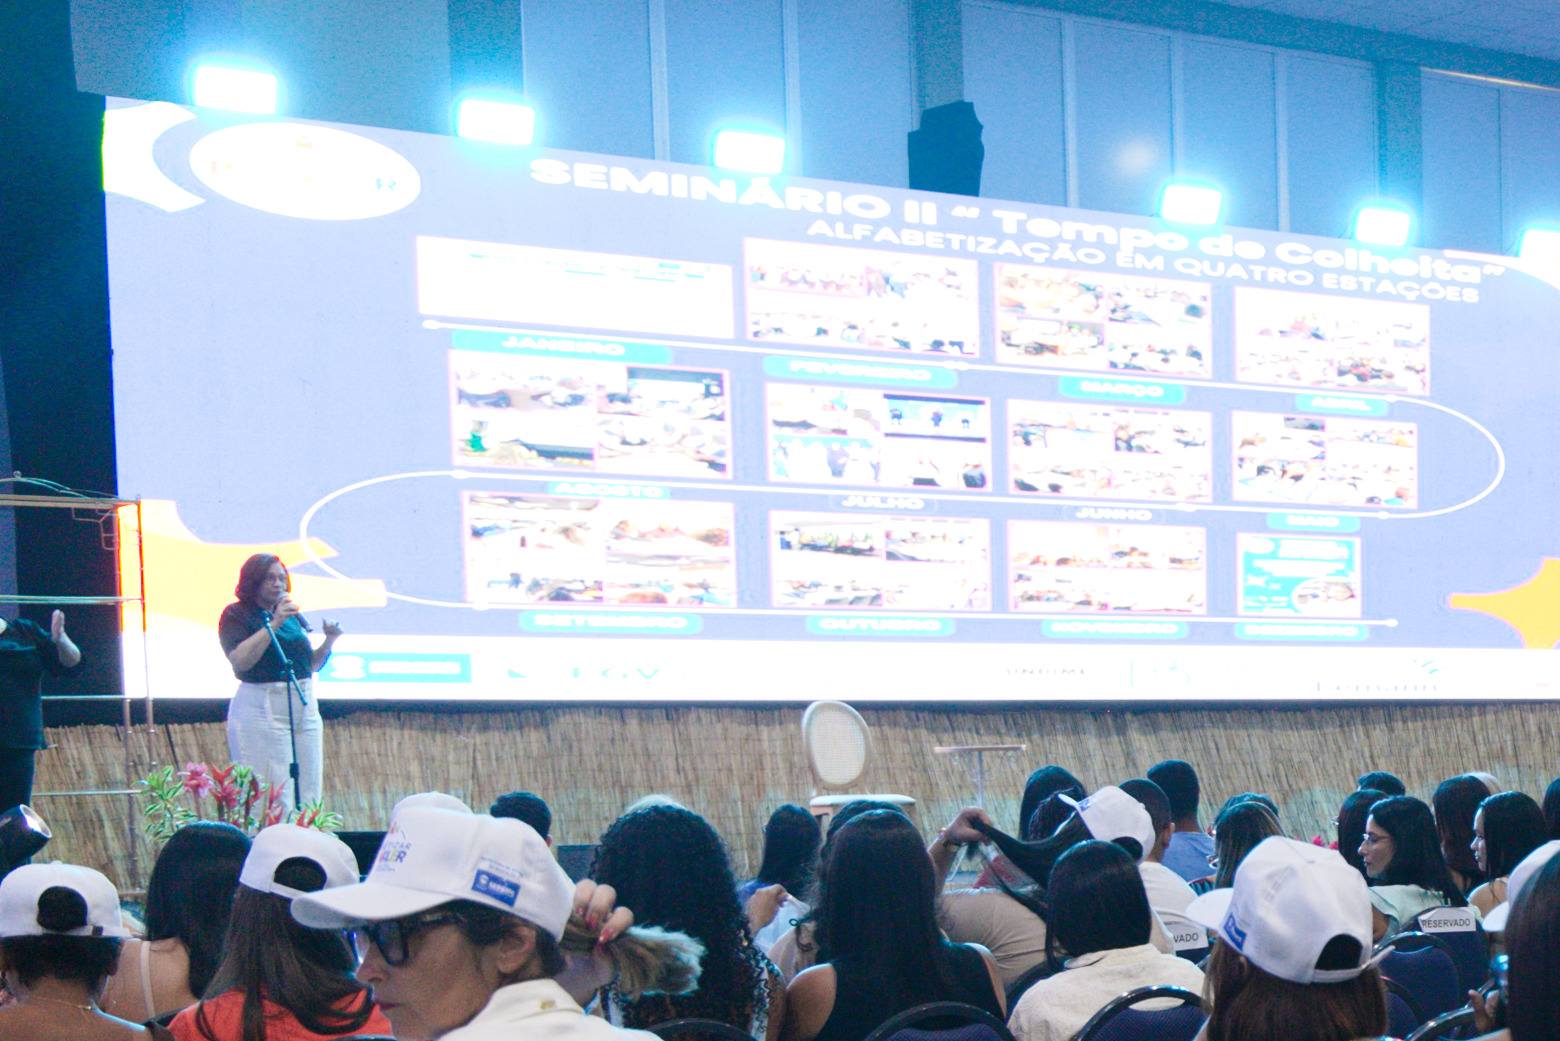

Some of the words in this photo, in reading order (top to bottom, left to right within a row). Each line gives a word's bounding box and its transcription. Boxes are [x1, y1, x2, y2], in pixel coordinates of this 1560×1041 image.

[529, 157, 892, 220] SEMINÁRIO
[903, 199, 938, 226] II
[992, 208, 1189, 255] Tempo
[1198, 233, 1266, 261] de
[807, 219, 1107, 264] ALFABETIZAÇÃO
[1116, 252, 1164, 272] EM
[1173, 257, 1315, 287] QUATRO
[1322, 273, 1480, 304] ESTAÇÕES
[1422, 918, 1471, 929] RESERVADO
